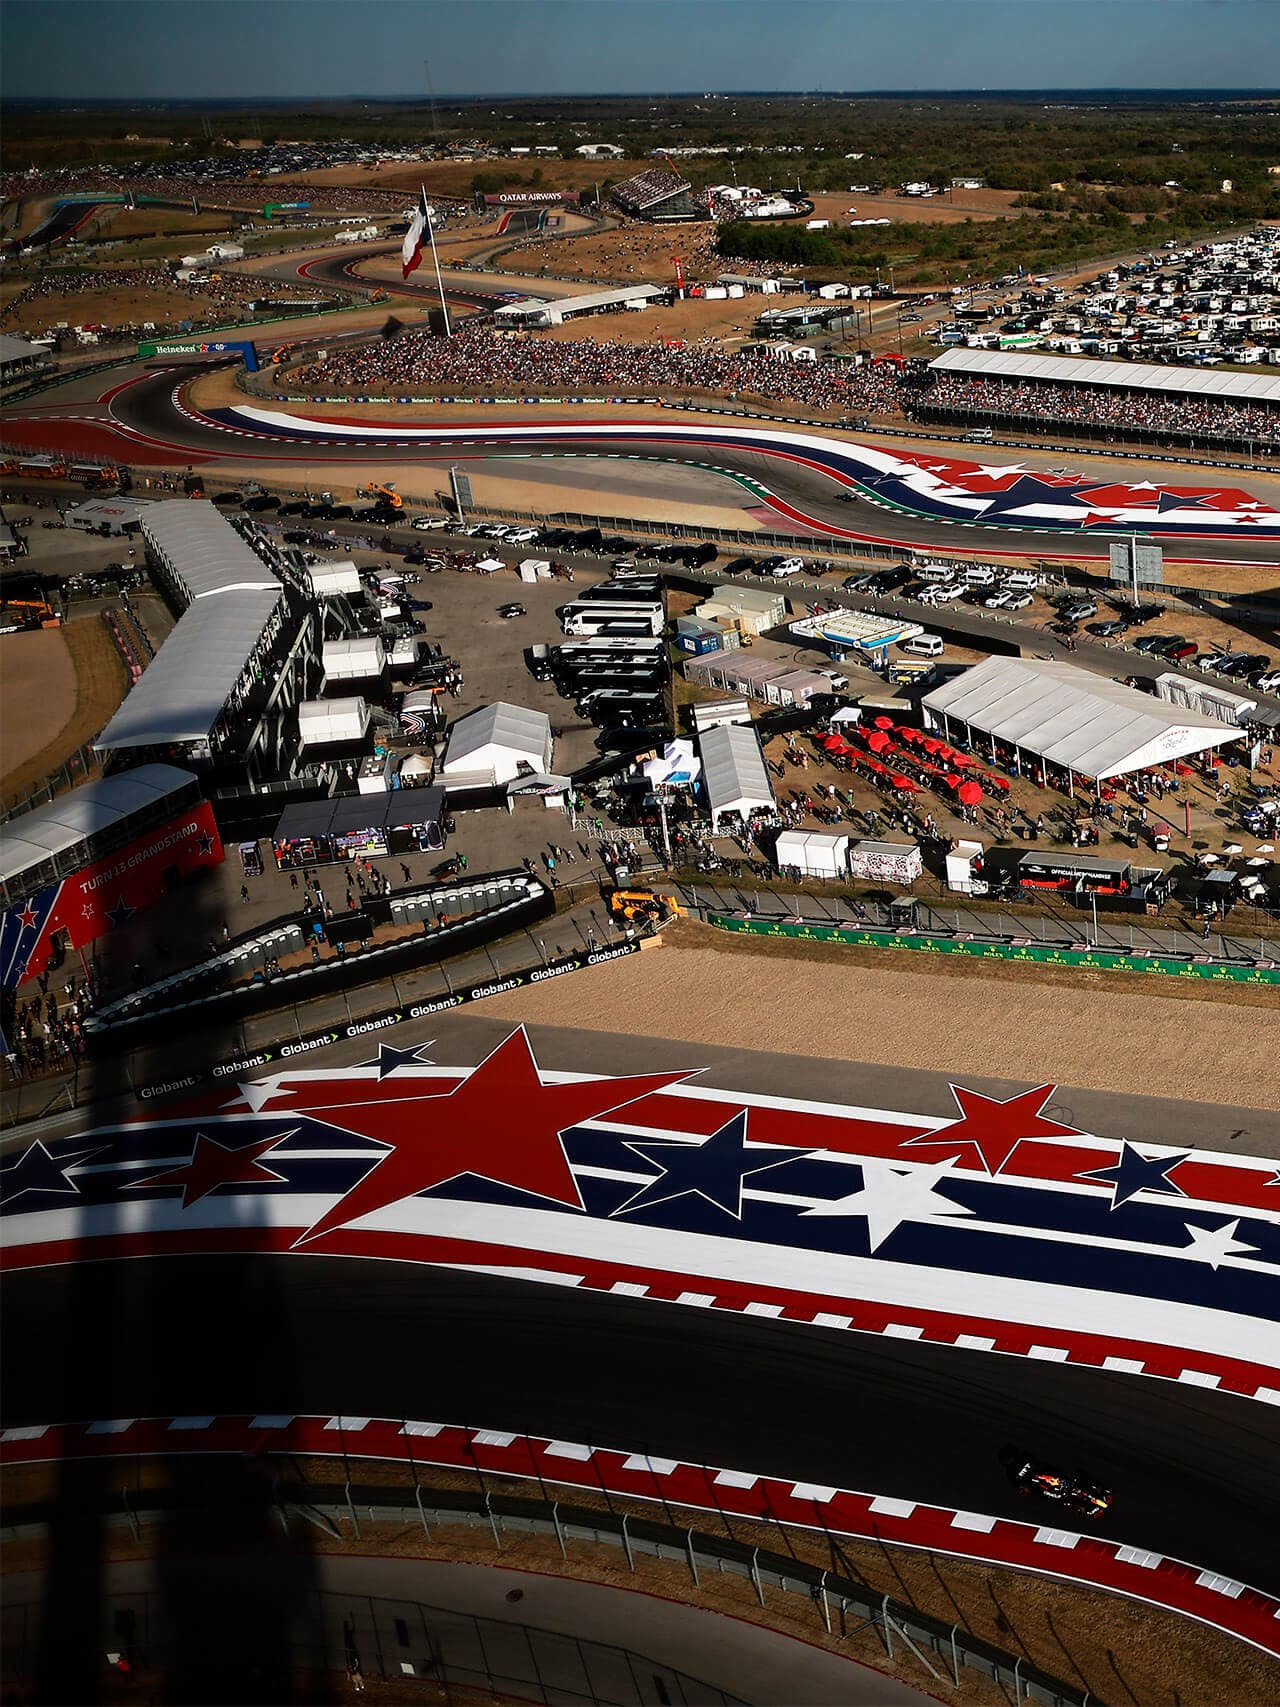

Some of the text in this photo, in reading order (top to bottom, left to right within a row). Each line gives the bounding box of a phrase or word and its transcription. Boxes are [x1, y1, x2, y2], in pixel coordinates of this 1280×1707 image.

[500, 193, 562, 202] QATAR AIRWAYS
[156, 344, 196, 354] Heineken
[79, 870, 113, 894] TURN
[127, 822, 198, 868] GRANDSTAND
[587, 945, 631, 965] Globant
[530, 962, 575, 982] Globant
[1179, 970, 1201, 978] ROLEX
[1247, 976, 1269, 984] ROLEX
[471, 979, 517, 1000] Globant
[410, 997, 457, 1018] Globant
[346, 1016, 396, 1037] Globant
[280, 1035, 331, 1057] Globant
[212, 1055, 265, 1078] Globant
[140, 1076, 196, 1099] Globant
